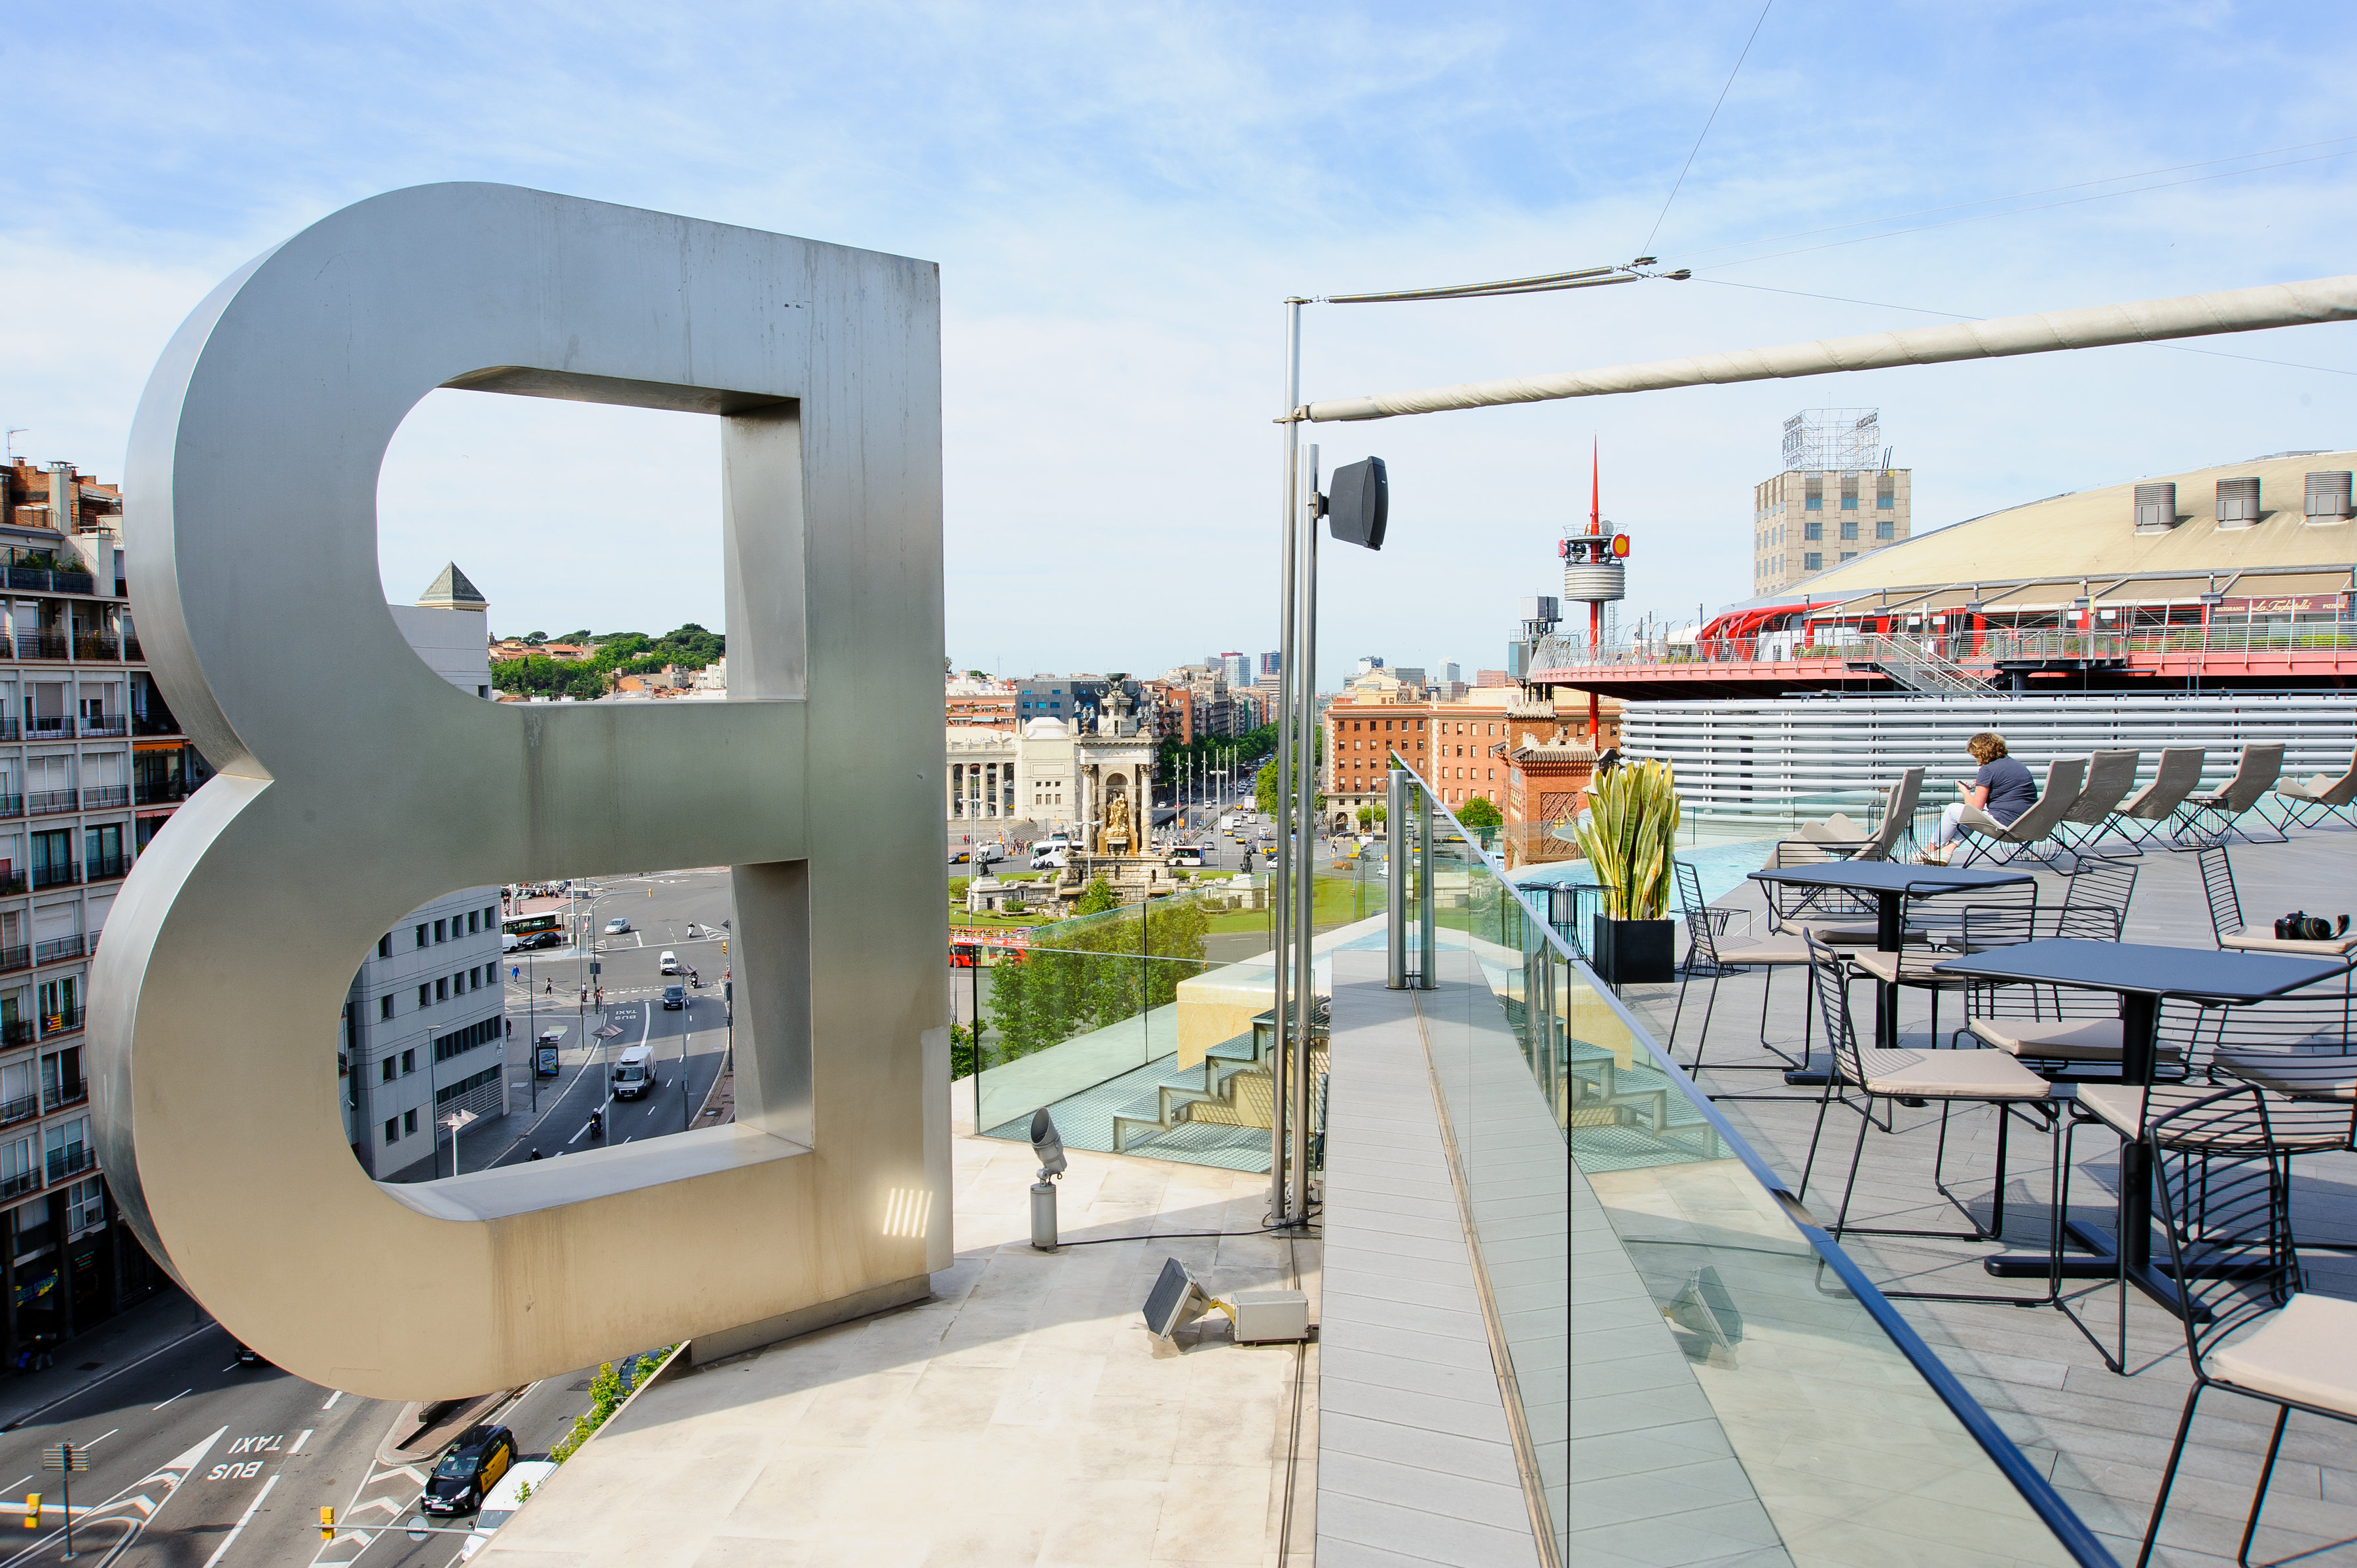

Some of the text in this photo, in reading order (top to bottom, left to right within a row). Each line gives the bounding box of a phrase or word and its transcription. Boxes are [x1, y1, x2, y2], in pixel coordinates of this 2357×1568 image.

[2252, 600, 2267, 611] La
[34, 1274, 58, 1293] SHOP
[227, 1434, 283, 1454] TAXI
[207, 1461, 264, 1480] BUS
